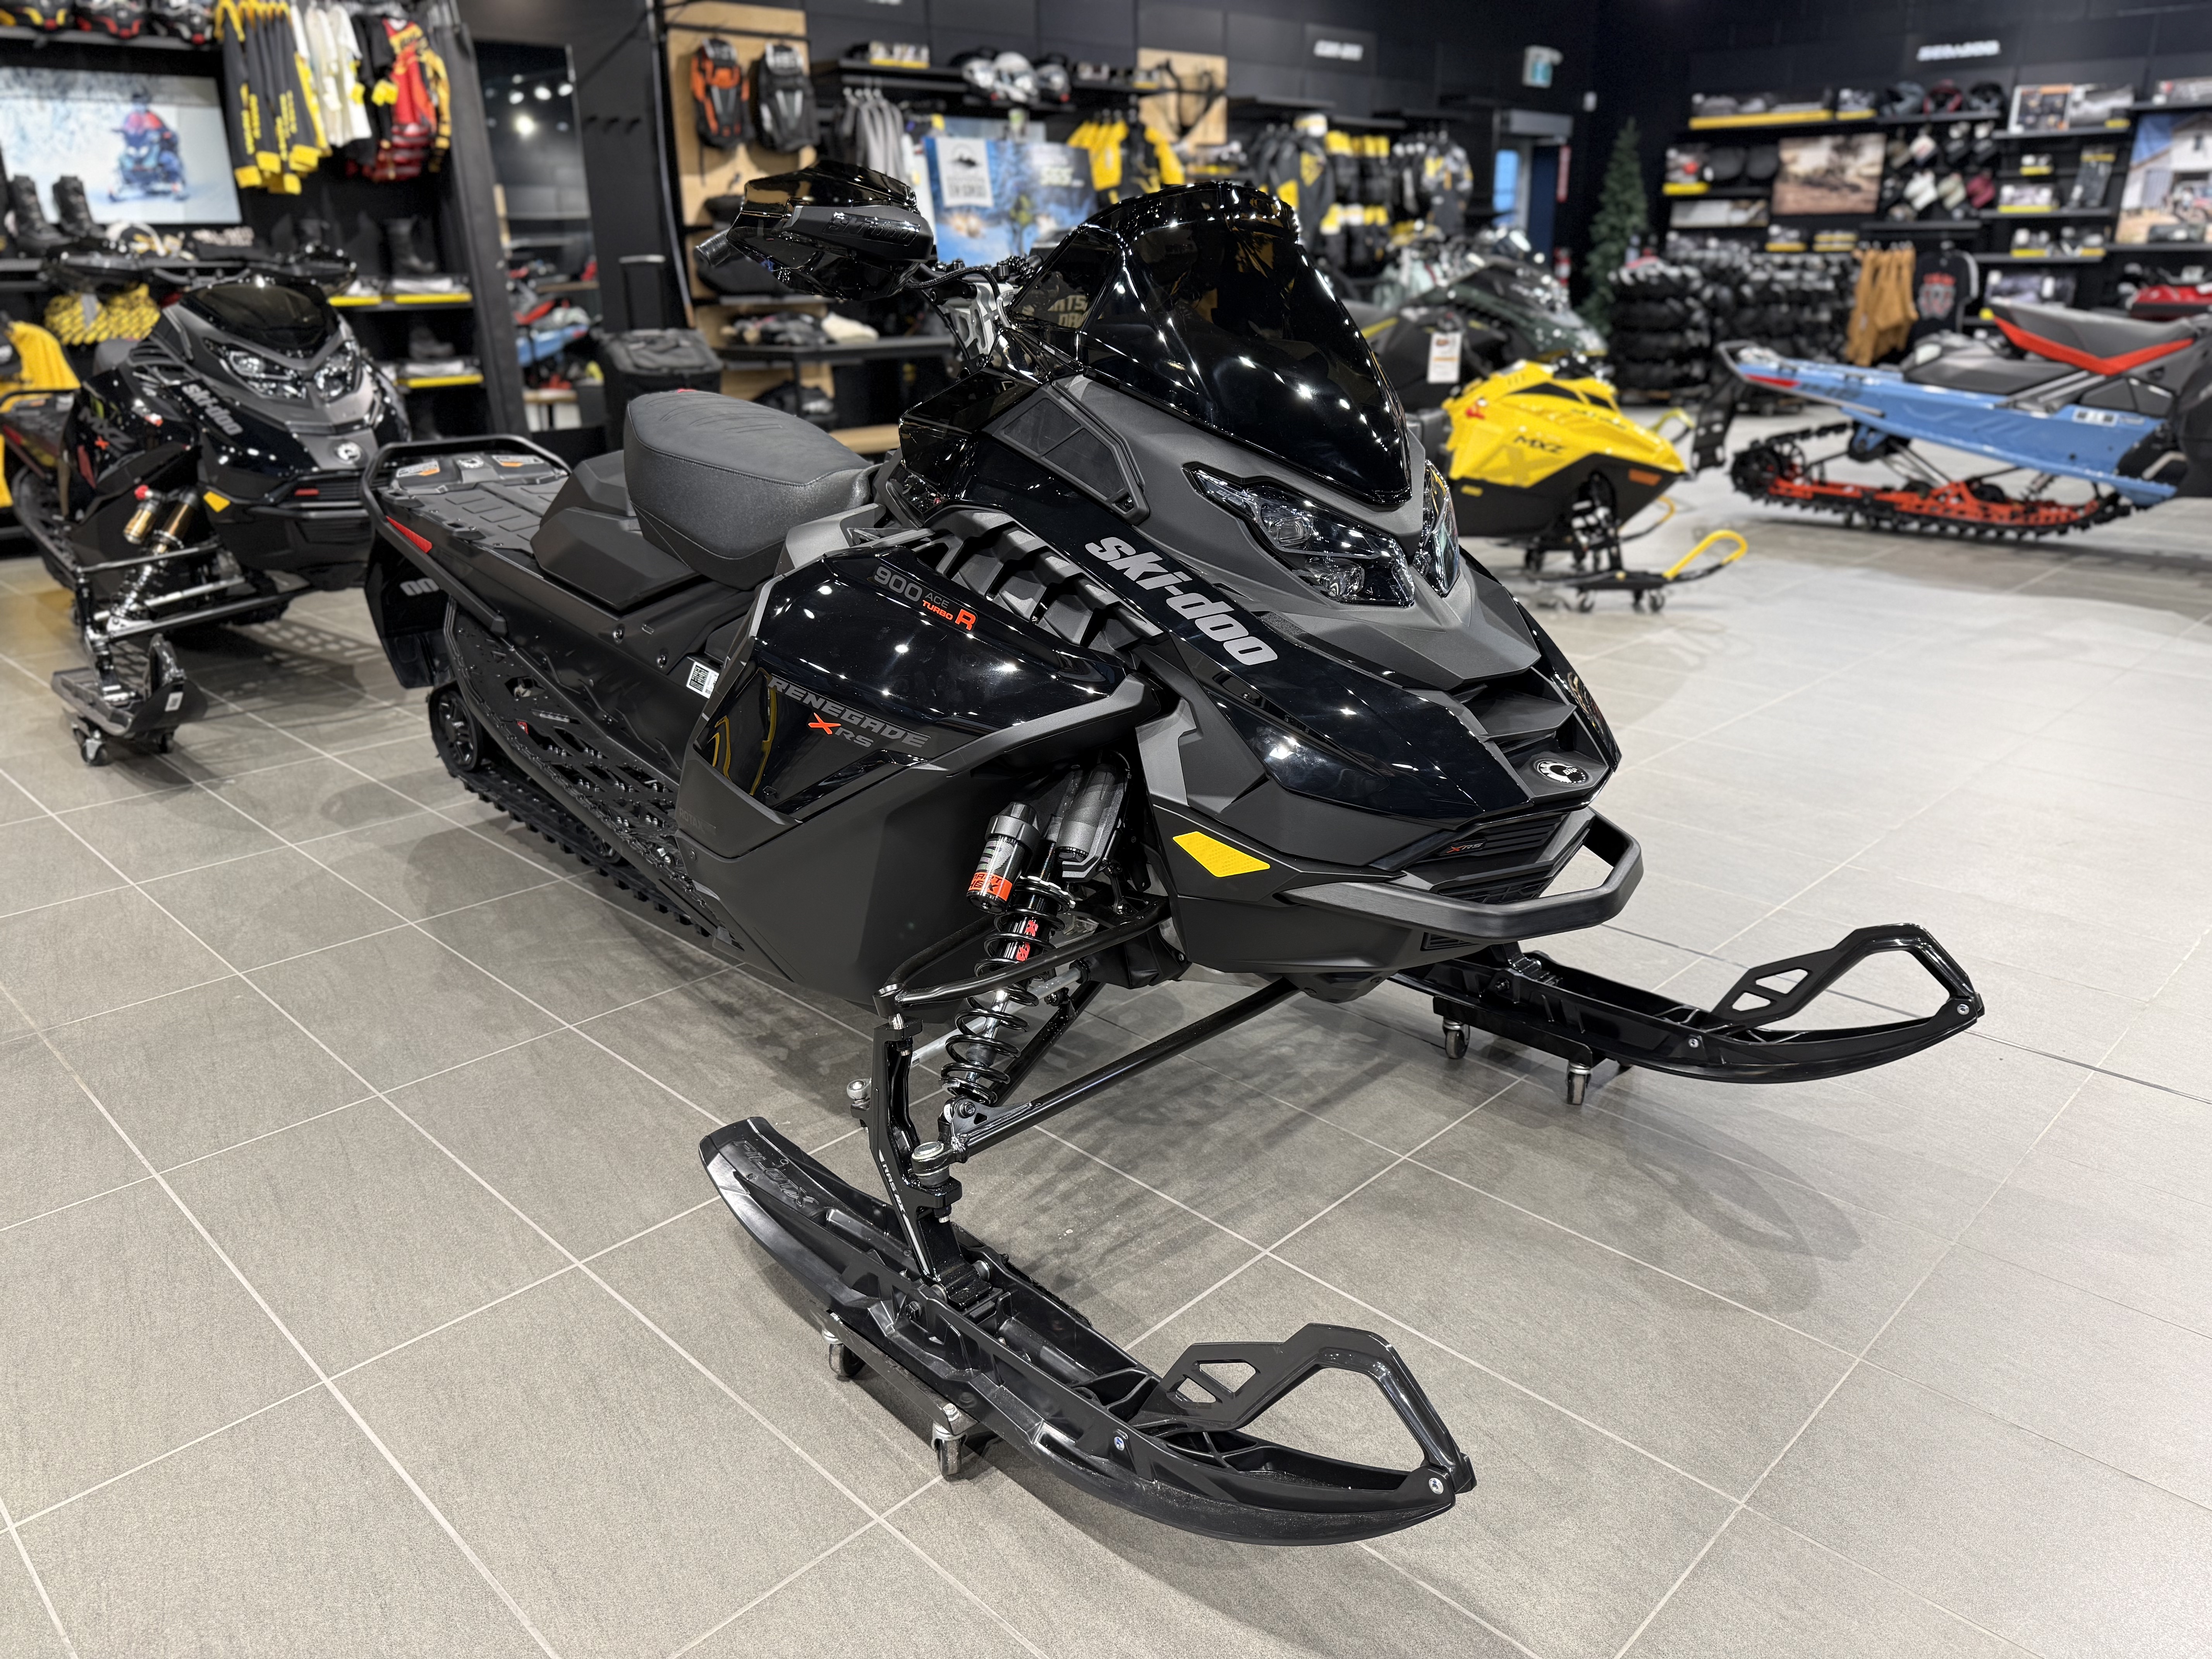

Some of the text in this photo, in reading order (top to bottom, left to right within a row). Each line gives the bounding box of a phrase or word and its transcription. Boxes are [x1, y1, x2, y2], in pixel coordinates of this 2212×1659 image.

[874, 566, 950, 608] 900 ACE
[922, 600, 976, 630] TURBO R
[768, 677, 929, 748] RENEGADE
[883, 1164, 897, 1192] RAS
